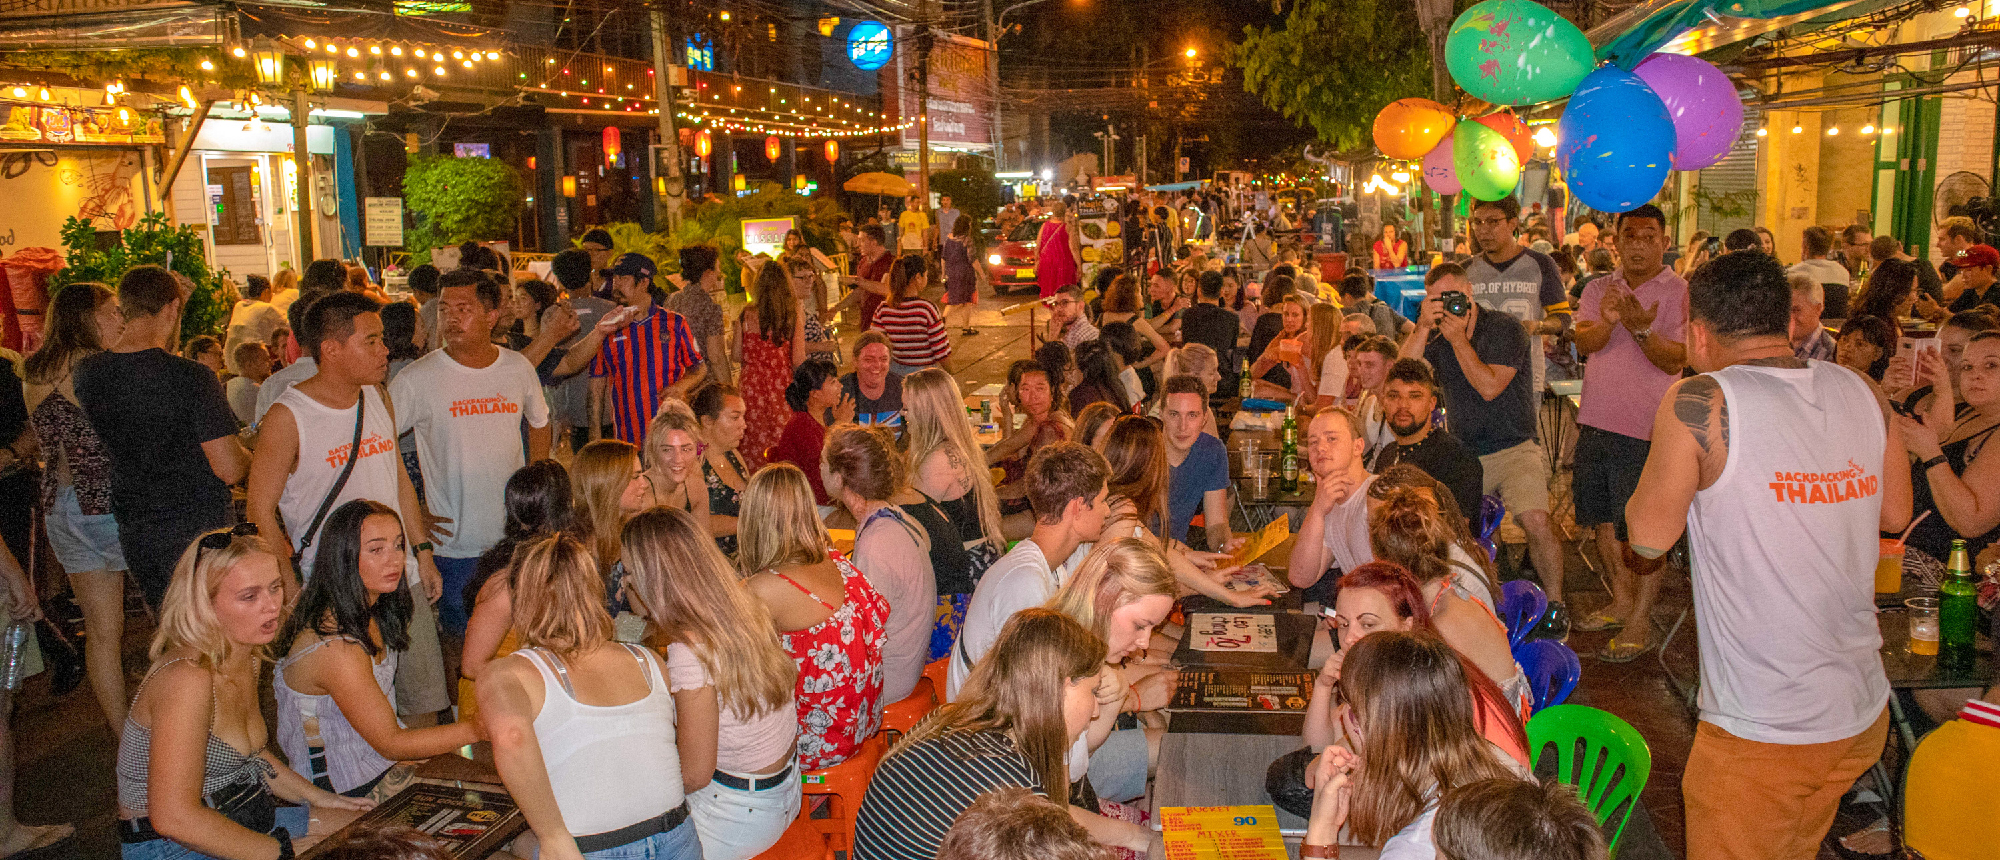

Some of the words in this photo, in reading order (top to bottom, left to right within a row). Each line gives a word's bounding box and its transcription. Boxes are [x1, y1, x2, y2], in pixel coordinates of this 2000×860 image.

[745, 233, 786, 244] MASSAG
[1502, 281, 1537, 293] HYBRID
[452, 397, 502, 406] BACKPACKING
[449, 402, 518, 418] THAILAND
[328, 436, 378, 456] BACKPKING
[325, 439, 394, 469] THILAND
[1775, 468, 1857, 483] BACKPACKING
[1769, 474, 1878, 504] THAILAND
[1186, 806, 1230, 814] BUCKET
[1233, 816, 1257, 826] 90
[1197, 830, 1242, 839] MIXER
